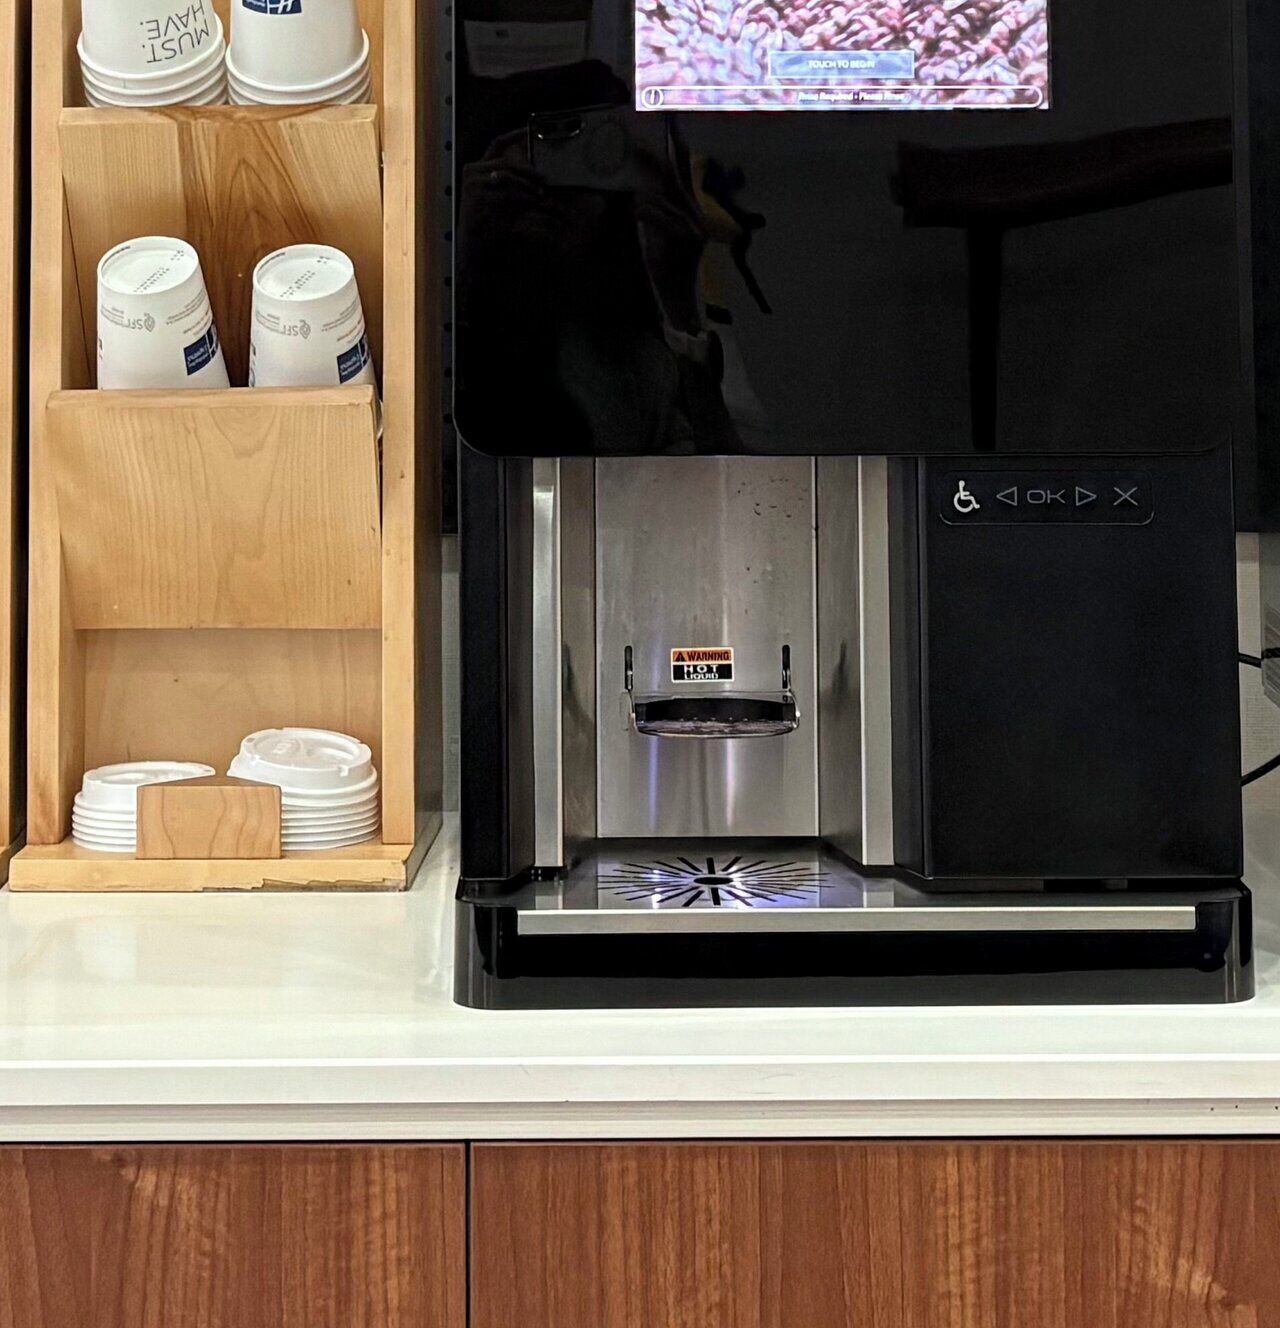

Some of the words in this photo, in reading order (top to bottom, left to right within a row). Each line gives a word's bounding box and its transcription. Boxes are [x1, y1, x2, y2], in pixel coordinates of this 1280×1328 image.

[141, 18, 210, 64] MUST.
[808, 59, 836, 69] TOUCH
[837, 59, 849, 69] TO
[1026, 488, 1066, 504] OK
[687, 651, 730, 662] WARNING
[683, 664, 719, 673] HOT
[684, 672, 719, 680] LIQUID
